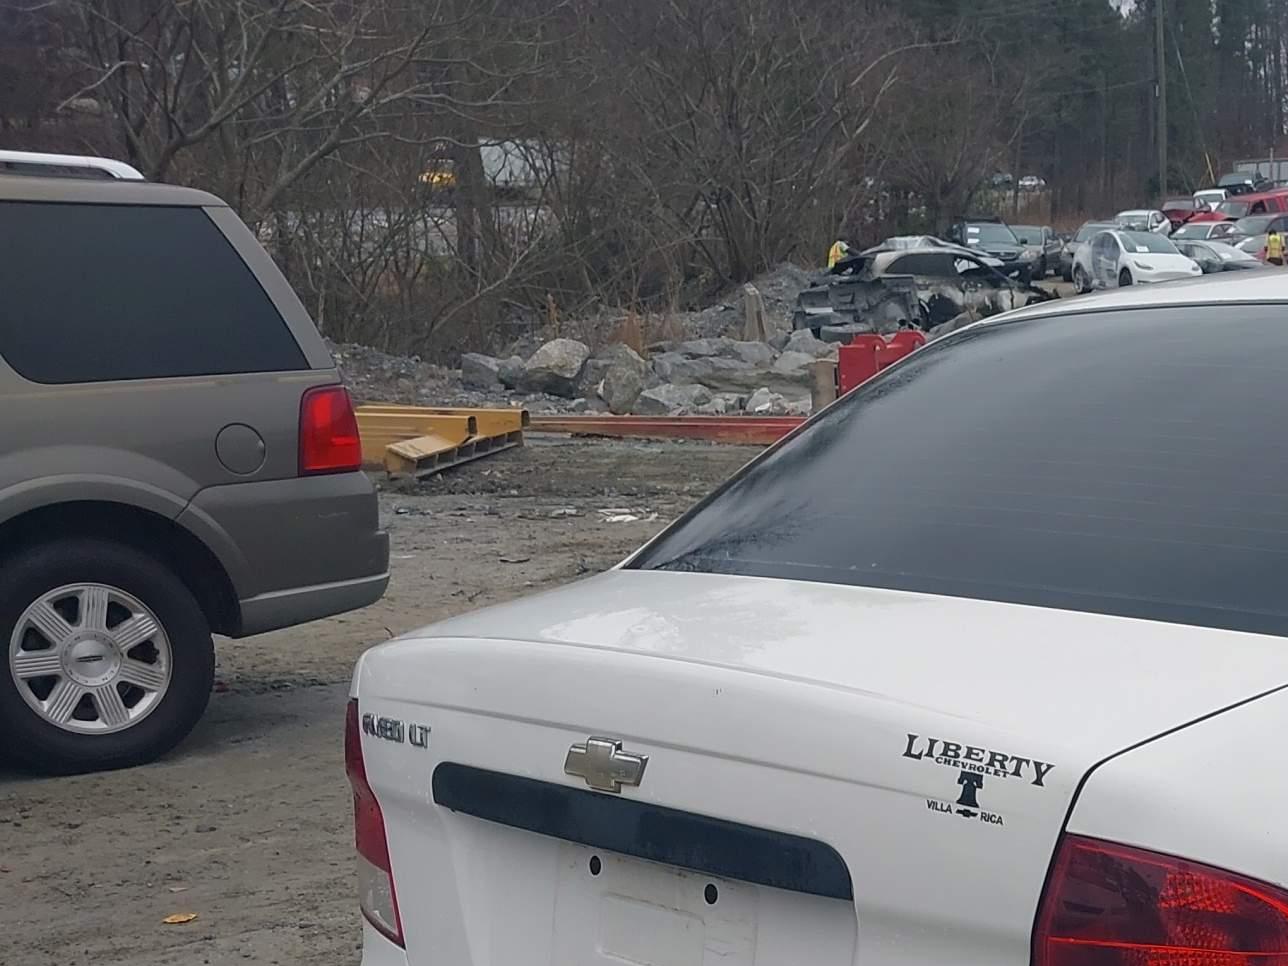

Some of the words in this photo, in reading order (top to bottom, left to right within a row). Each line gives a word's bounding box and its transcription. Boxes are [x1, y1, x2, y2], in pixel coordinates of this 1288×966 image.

[409, 723, 431, 749] LT
[902, 733, 1056, 787] LIBERTY
[935, 756, 1010, 778] CHEVROLET
[926, 799, 953, 815] VILLA
[980, 811, 1004, 826] RICA
